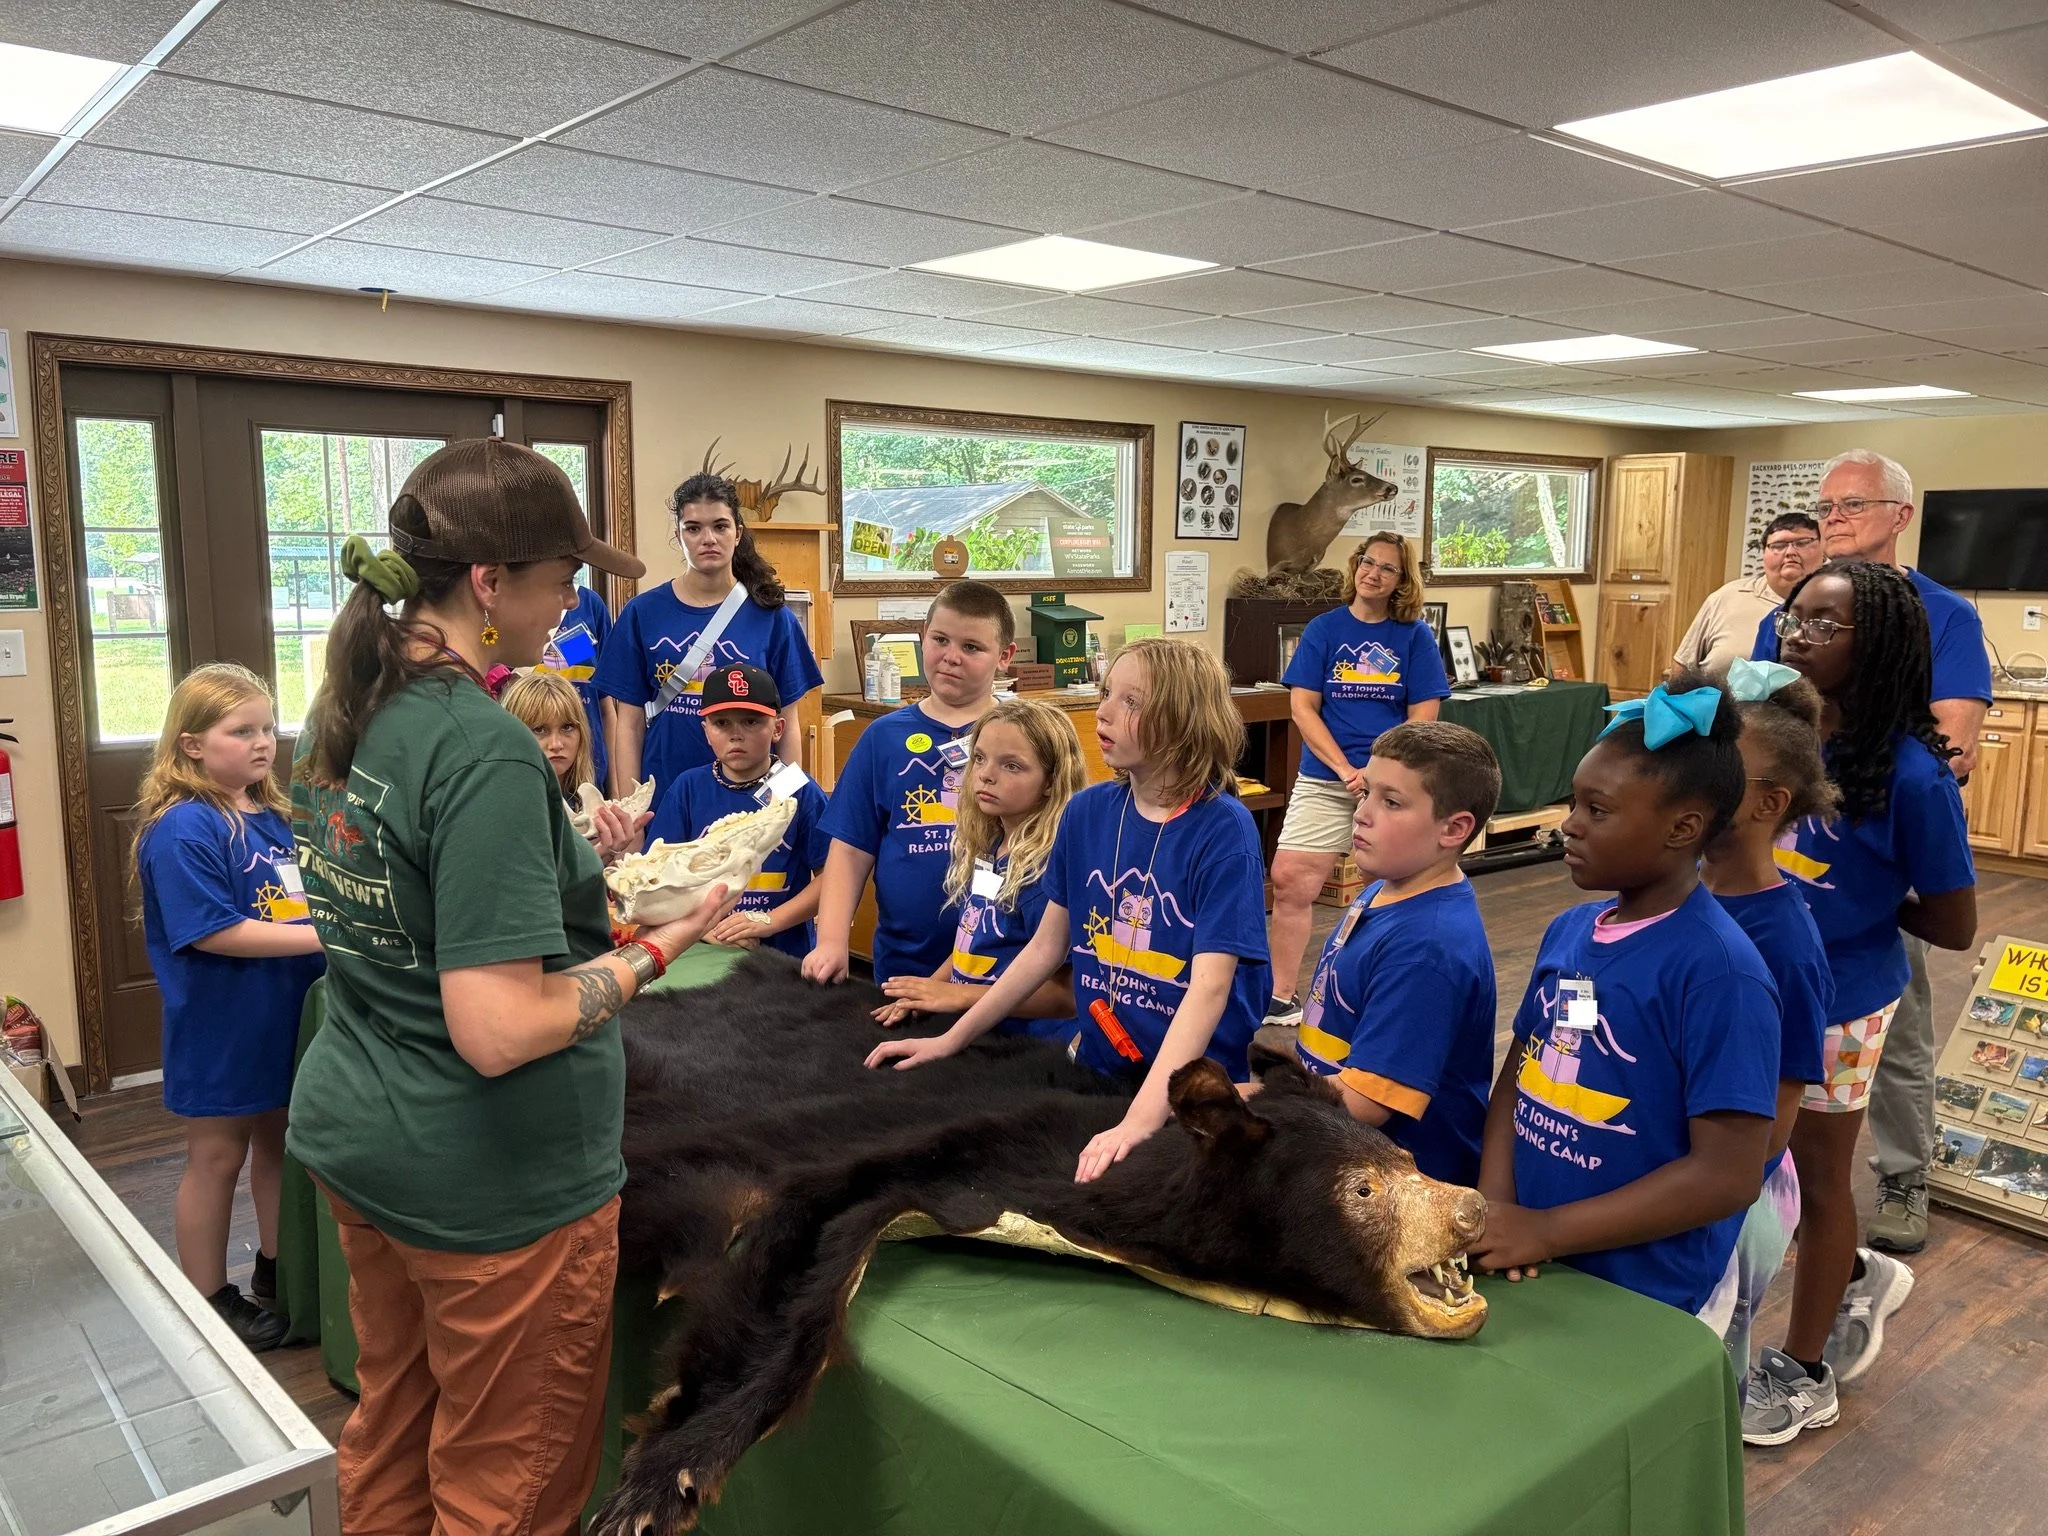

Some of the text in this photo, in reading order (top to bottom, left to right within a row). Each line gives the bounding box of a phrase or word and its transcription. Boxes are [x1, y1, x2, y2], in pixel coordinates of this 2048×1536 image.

[1752, 464, 1782, 472] BACKYARD
[853, 538, 887, 555] OPEN
[1062, 667, 1079, 675] KSFF
[1331, 691, 1369, 699] READING
[1355, 685, 1386, 693] JOHN'S
[924, 829, 941, 839] ST.
[908, 842, 949, 853] READI
[311, 908, 338, 923] ERVE
[1109, 971, 1157, 996] JOHN'S
[2019, 974, 2041, 993] IS
[1135, 995, 1176, 1017] CAMP
[1529, 1106, 1579, 1142] JOHN'S
[1549, 1140, 1603, 1170] CAMP
